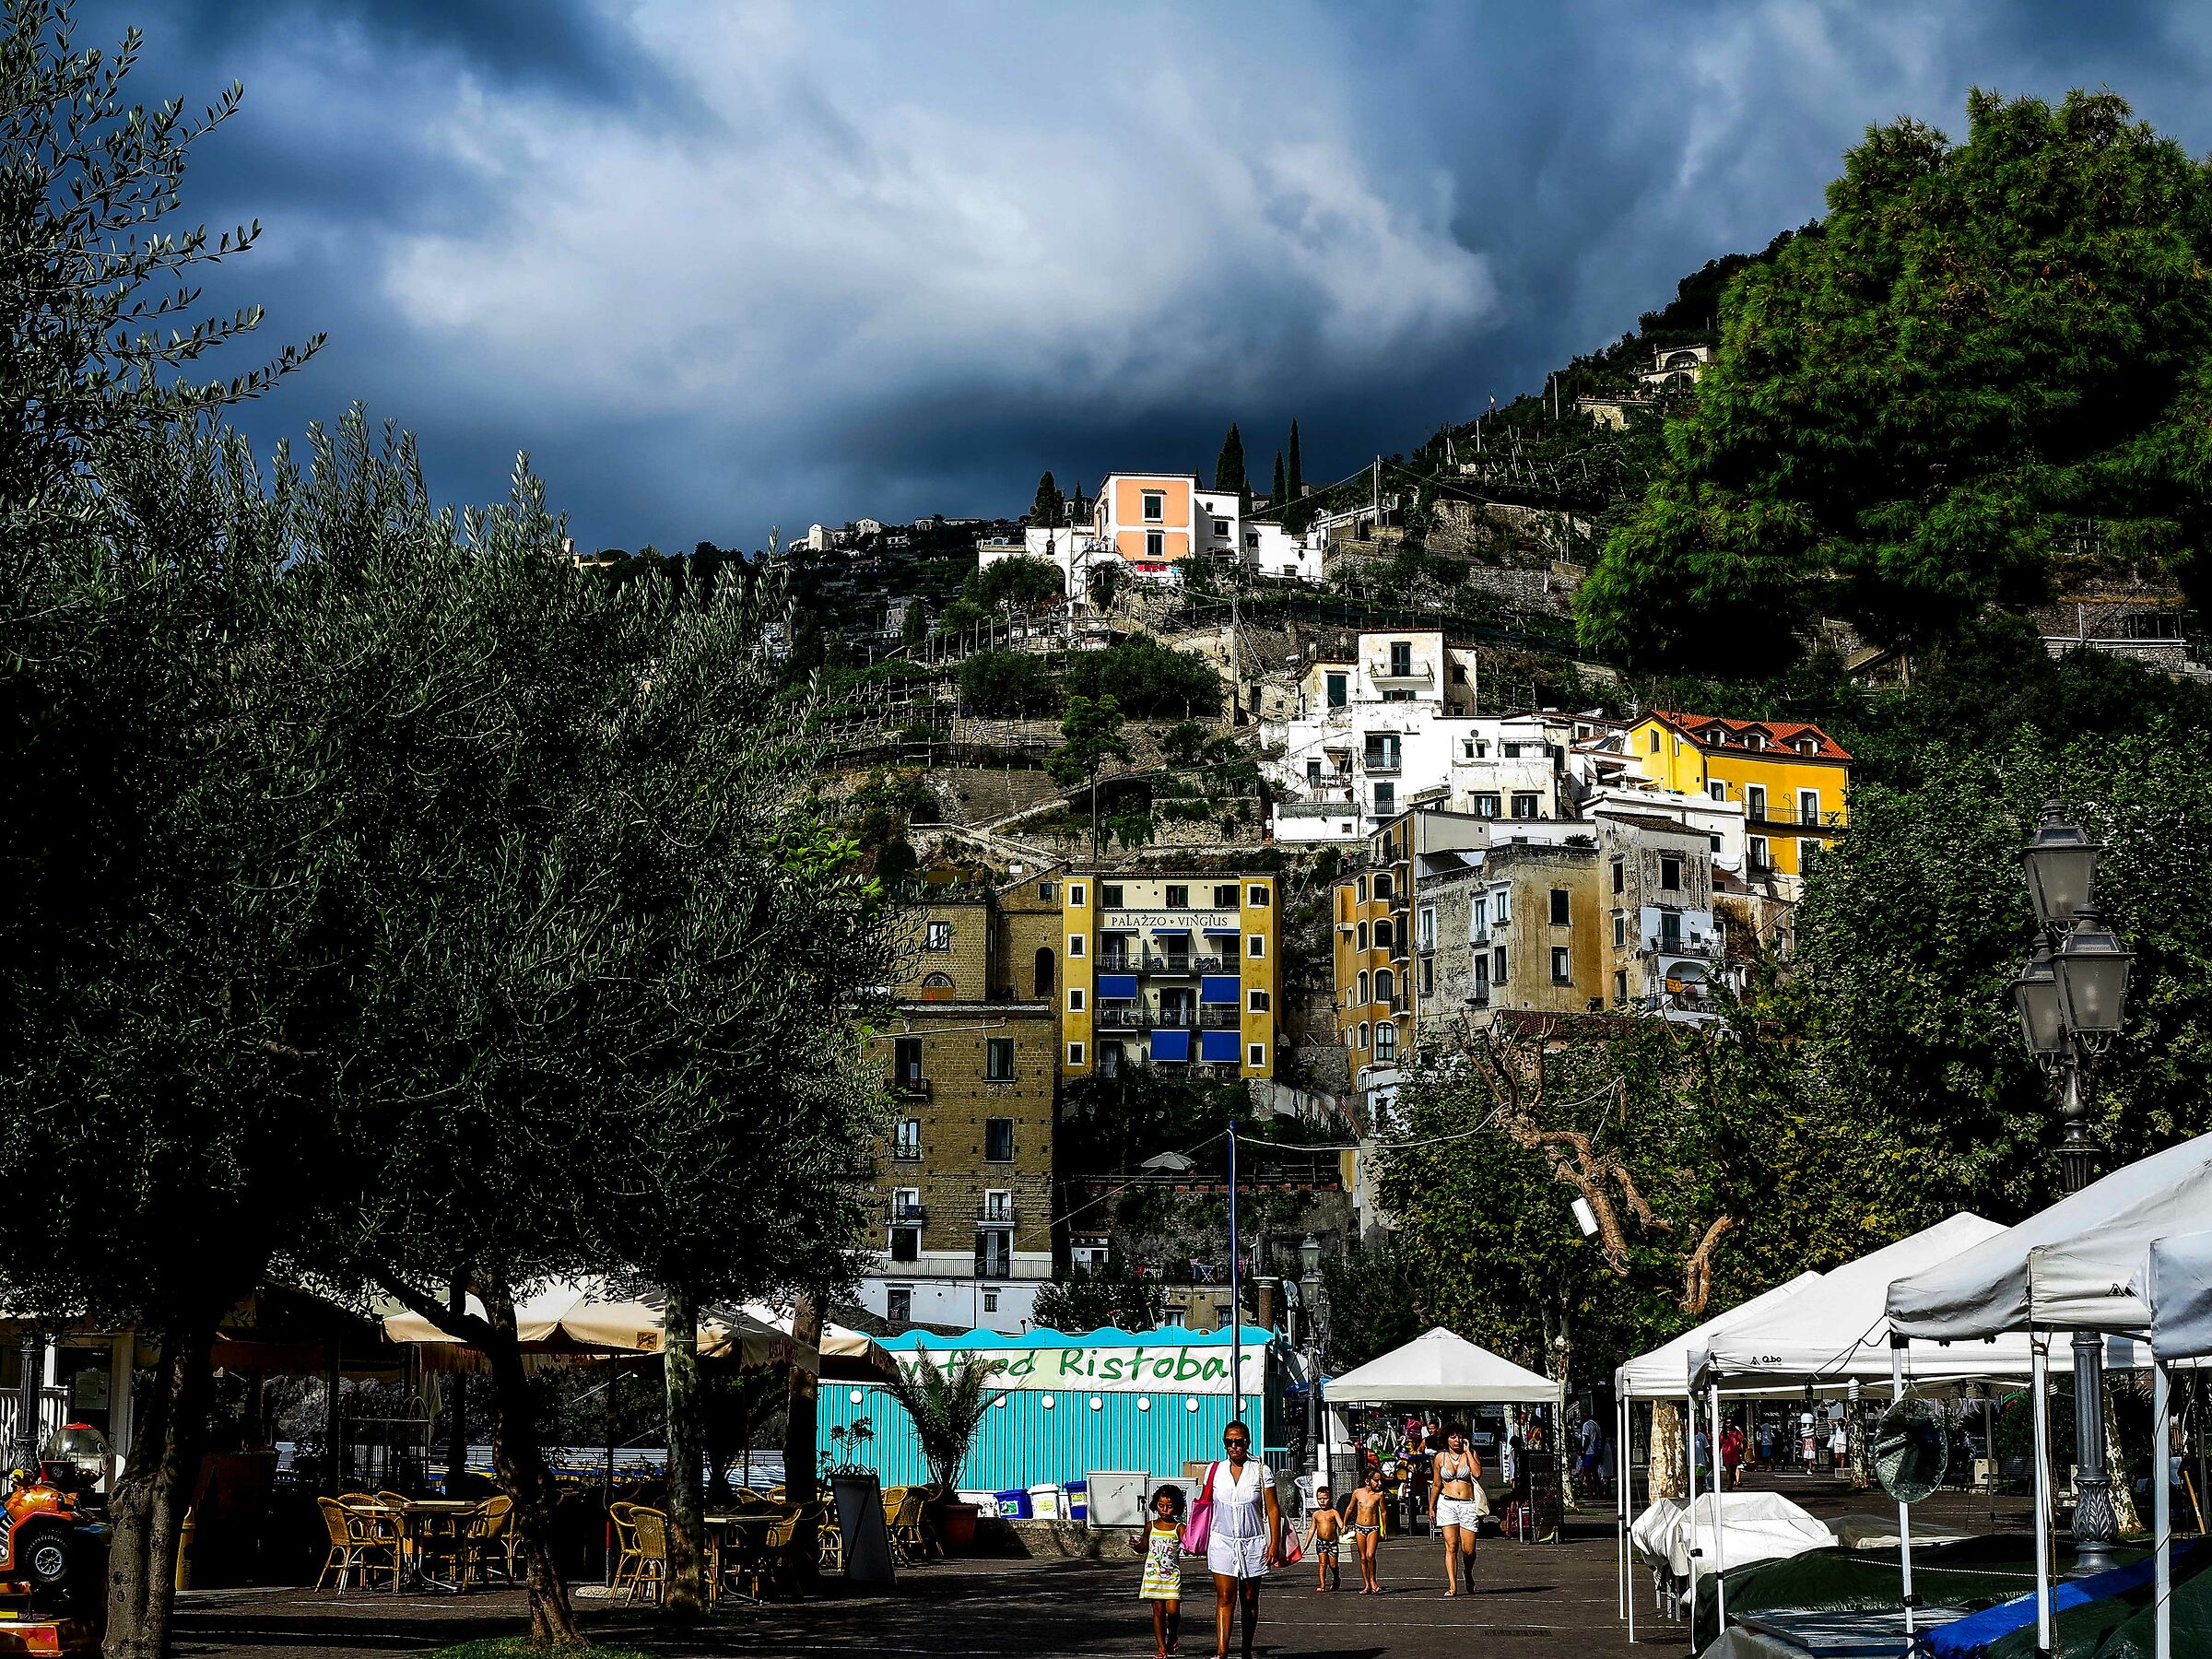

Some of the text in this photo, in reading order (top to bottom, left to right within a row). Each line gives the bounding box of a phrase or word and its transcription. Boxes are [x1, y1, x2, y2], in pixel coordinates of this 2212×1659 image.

[1112, 915, 1229, 927] PALAZZO VINGIUS
[1059, 1346, 1252, 1382] Ristobar
[1761, 1355, 1783, 1363] Q.bo
